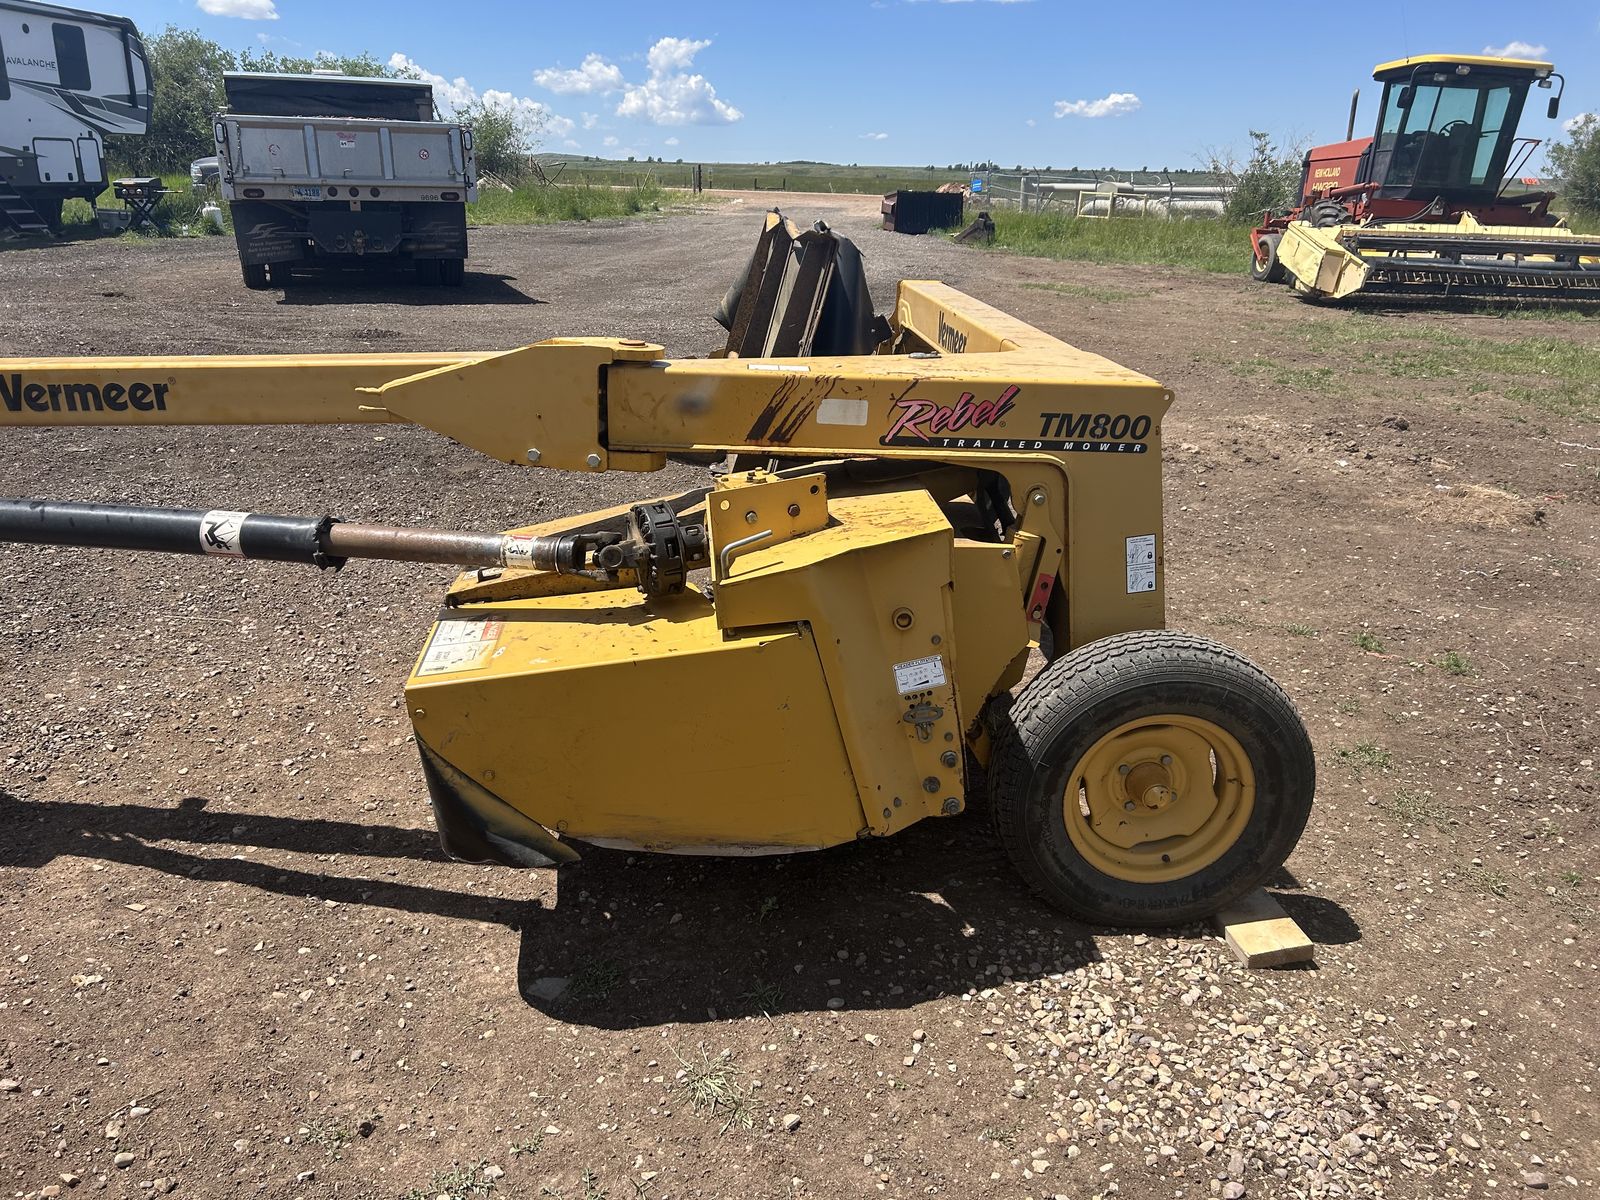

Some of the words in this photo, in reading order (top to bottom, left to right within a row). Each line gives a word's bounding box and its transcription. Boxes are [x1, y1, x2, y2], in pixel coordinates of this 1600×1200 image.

[6, 56, 57, 69] AVALANCHE
[938, 310, 968, 354] Vermeer
[884, 384, 1021, 443] Rebel
[1039, 412, 1151, 440] TM800
[942, 438, 1042, 450] TRAILED
[1063, 442, 1142, 452] MOWER
